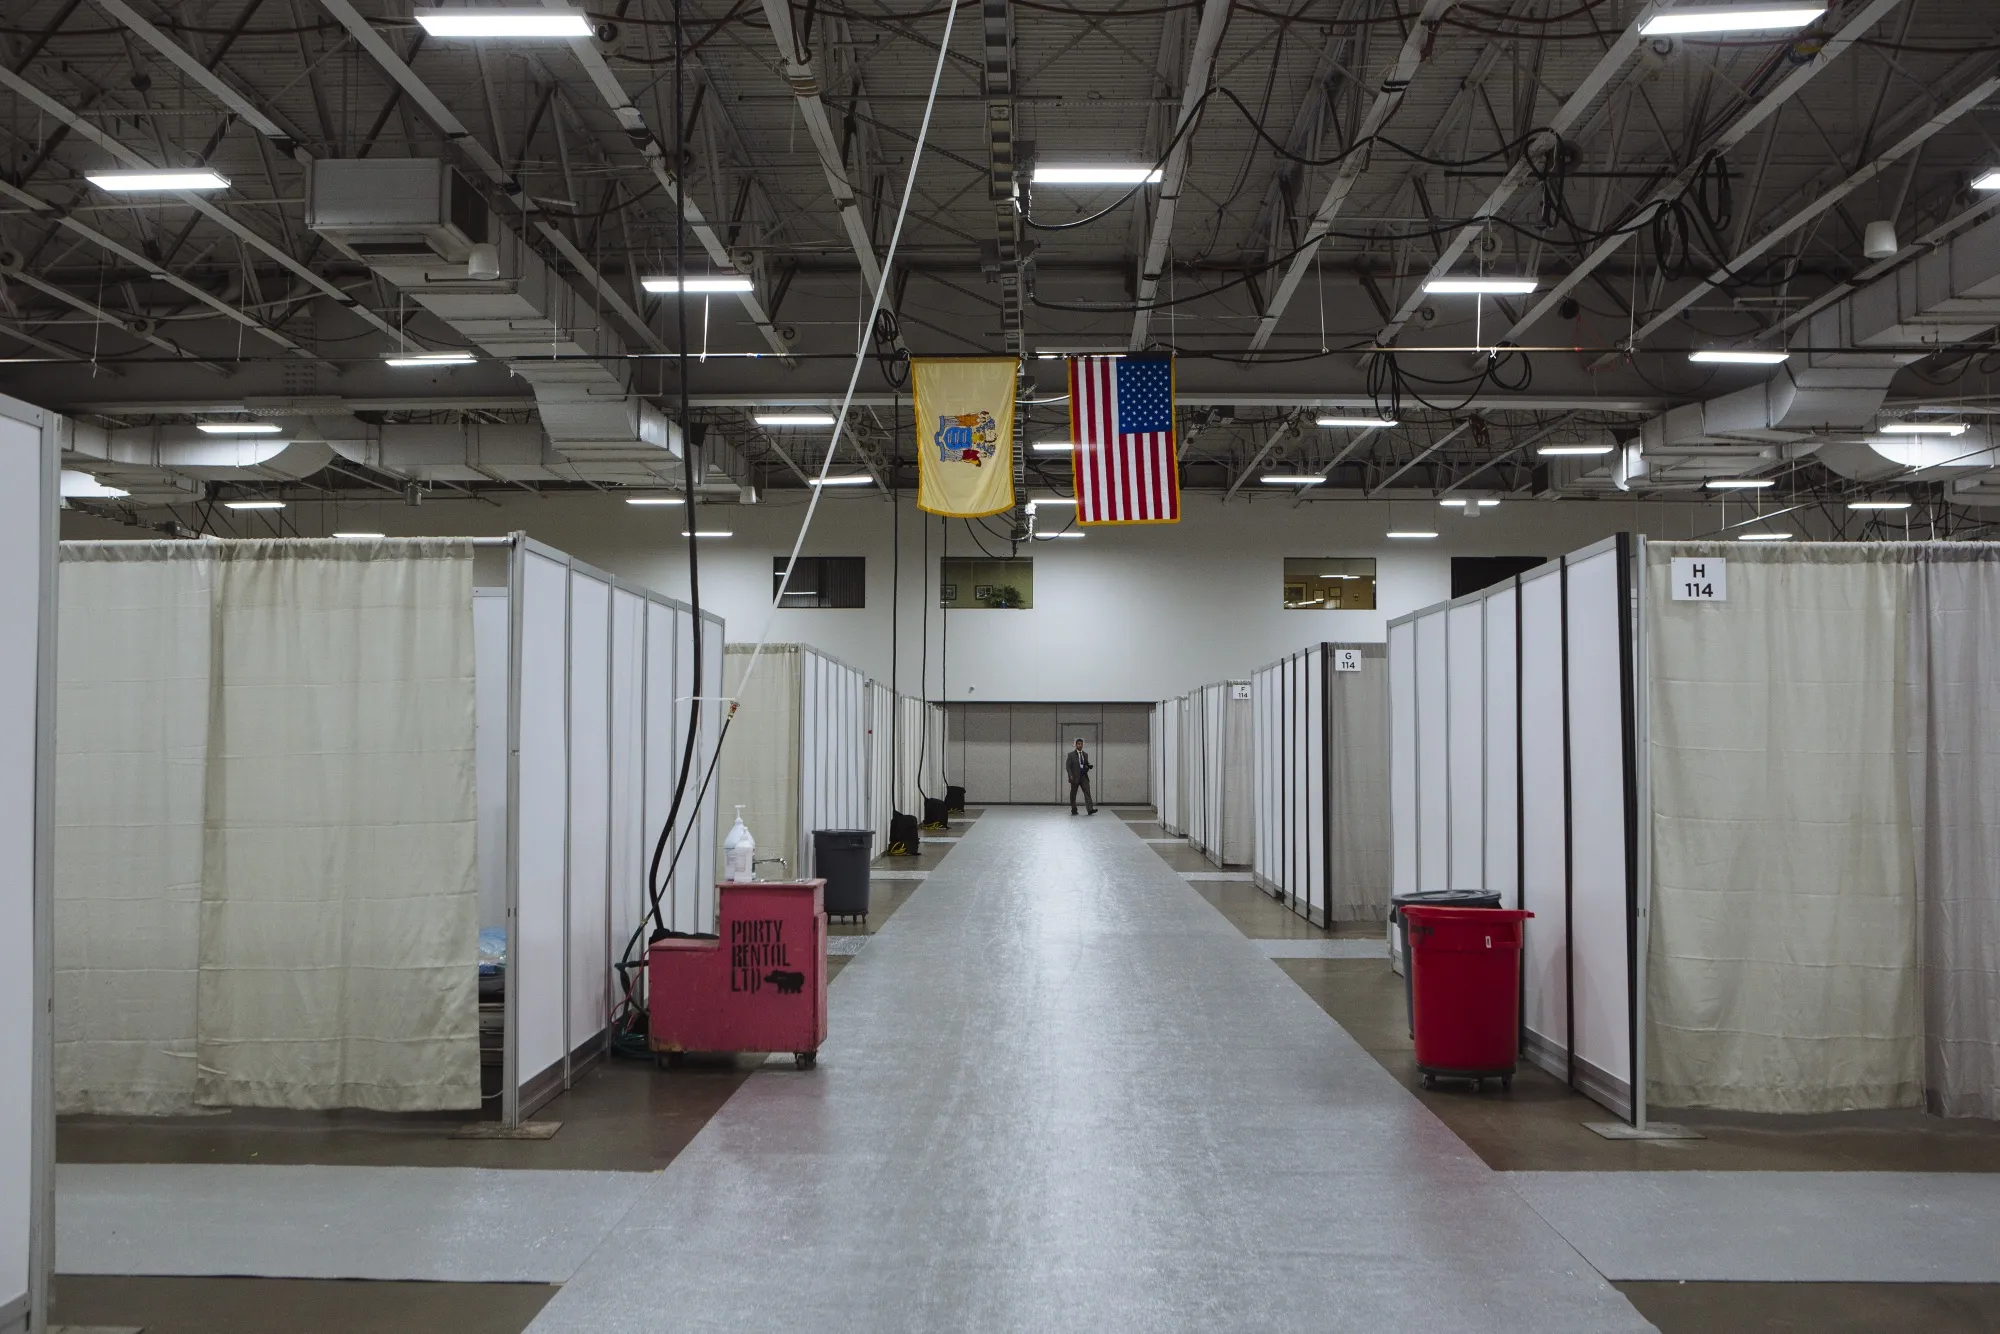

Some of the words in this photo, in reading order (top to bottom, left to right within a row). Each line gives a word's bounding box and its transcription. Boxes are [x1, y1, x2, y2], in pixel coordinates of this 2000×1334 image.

[1693, 564, 1705, 578] H
[1685, 583, 1714, 597] 114
[1345, 652, 1352, 660] G
[1341, 661, 1356, 669] 114
[731, 920, 783, 943] PARTY
[731, 944, 791, 967] RENTAL
[731, 968, 761, 993] LTD
